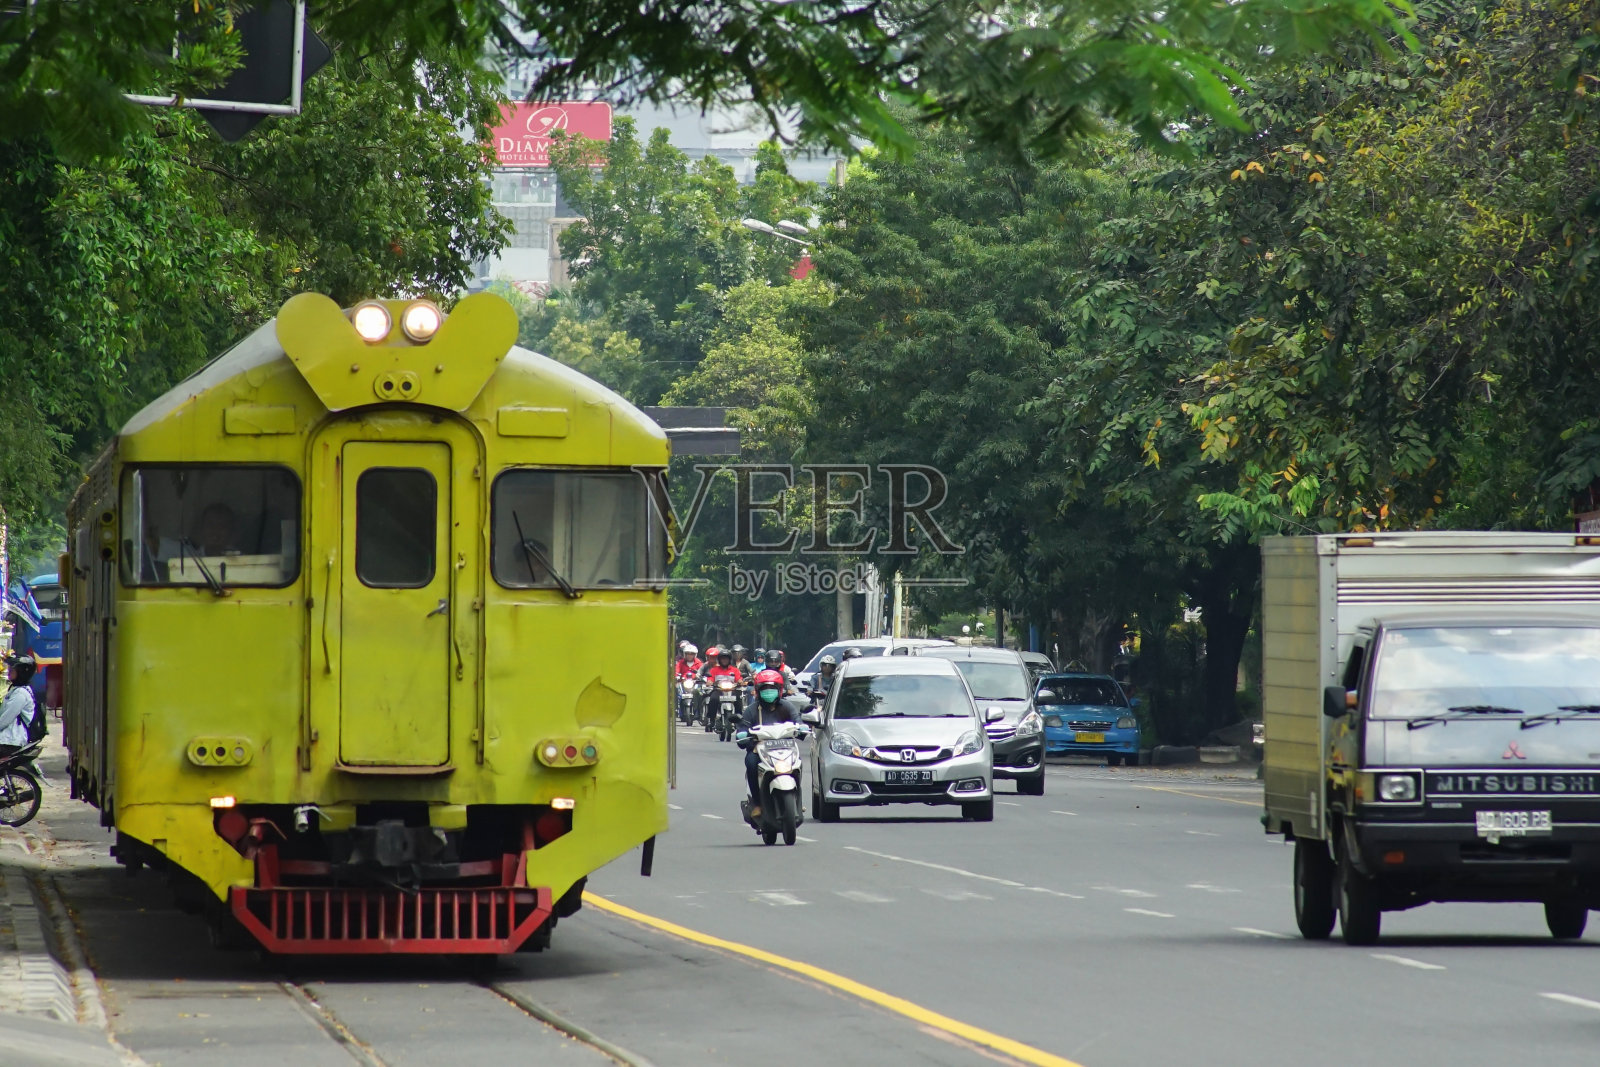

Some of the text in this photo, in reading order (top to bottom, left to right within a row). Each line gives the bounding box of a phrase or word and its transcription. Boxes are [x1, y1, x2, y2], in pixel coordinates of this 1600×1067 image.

[887, 771, 897, 780] AD
[1437, 776, 1595, 791] MITSUBISHI
[1499, 810, 1529, 828] 1606
[1531, 810, 1551, 828] PB
